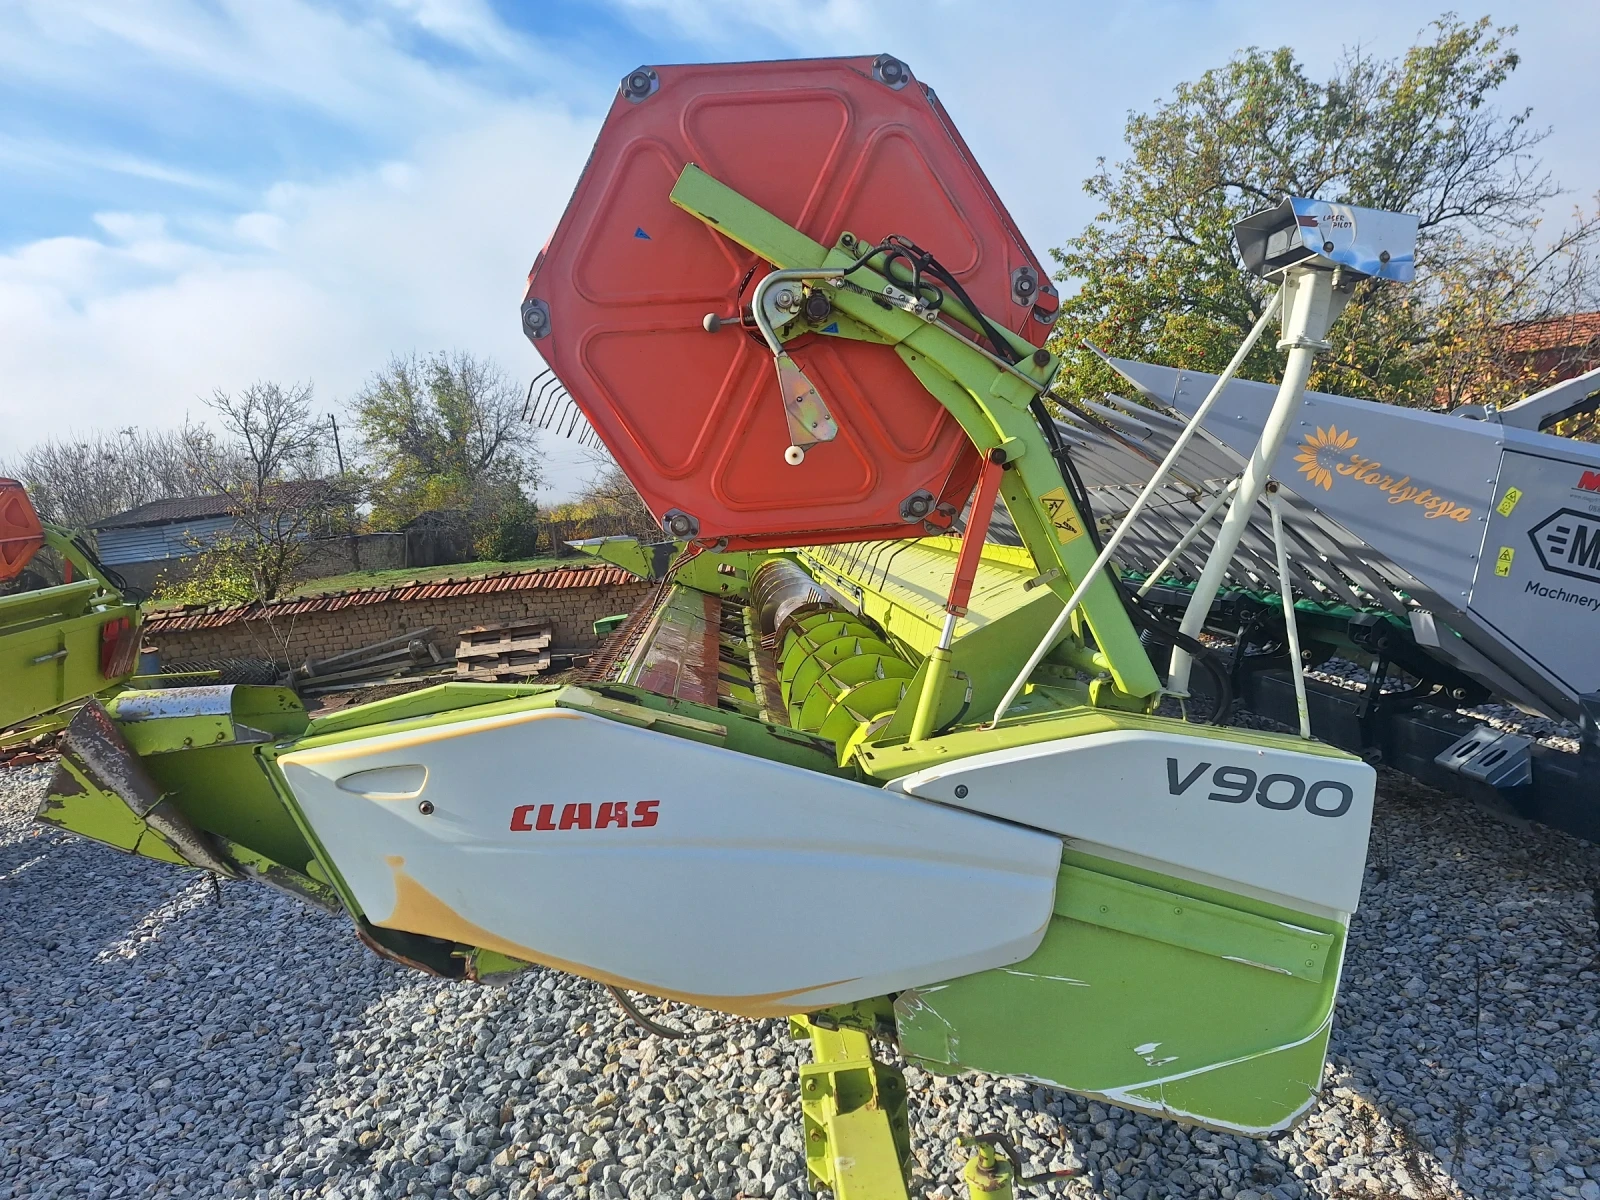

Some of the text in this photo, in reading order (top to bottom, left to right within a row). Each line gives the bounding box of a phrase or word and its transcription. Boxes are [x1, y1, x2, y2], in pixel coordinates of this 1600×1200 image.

[1322, 214, 1345, 222] LASER
[1332, 221, 1353, 229] PILOT
[1335, 453, 1471, 523] Horlytsya
[1524, 580, 1600, 612] Machinery
[509, 799, 661, 832] CLAAS
